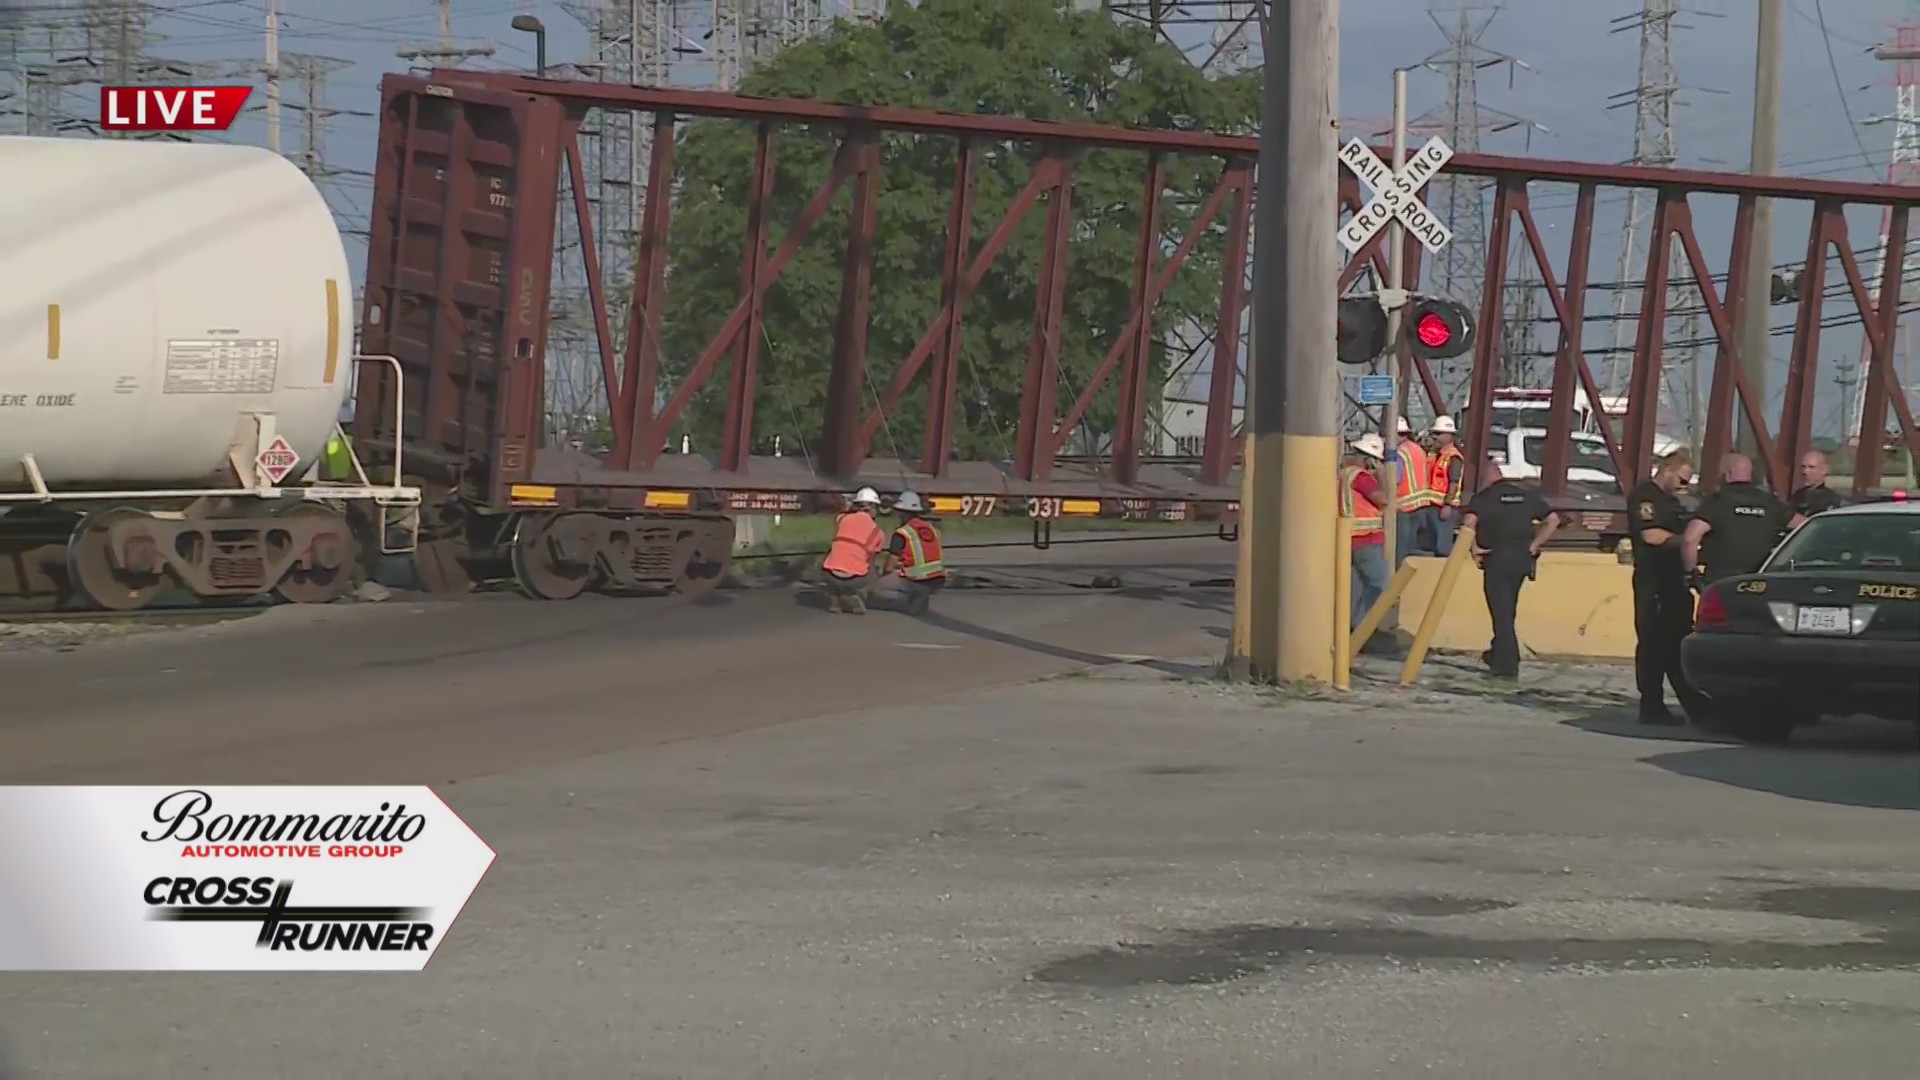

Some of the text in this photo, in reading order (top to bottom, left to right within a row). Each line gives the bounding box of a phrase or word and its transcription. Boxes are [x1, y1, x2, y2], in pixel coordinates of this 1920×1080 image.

[1344, 143, 1446, 247] RAIL ROAD
[1347, 146, 1443, 243] CROSSING
[36, 393, 76, 407] OXIDE
[961, 496, 996, 516] 977
[1857, 584, 1917, 599] POLICE
